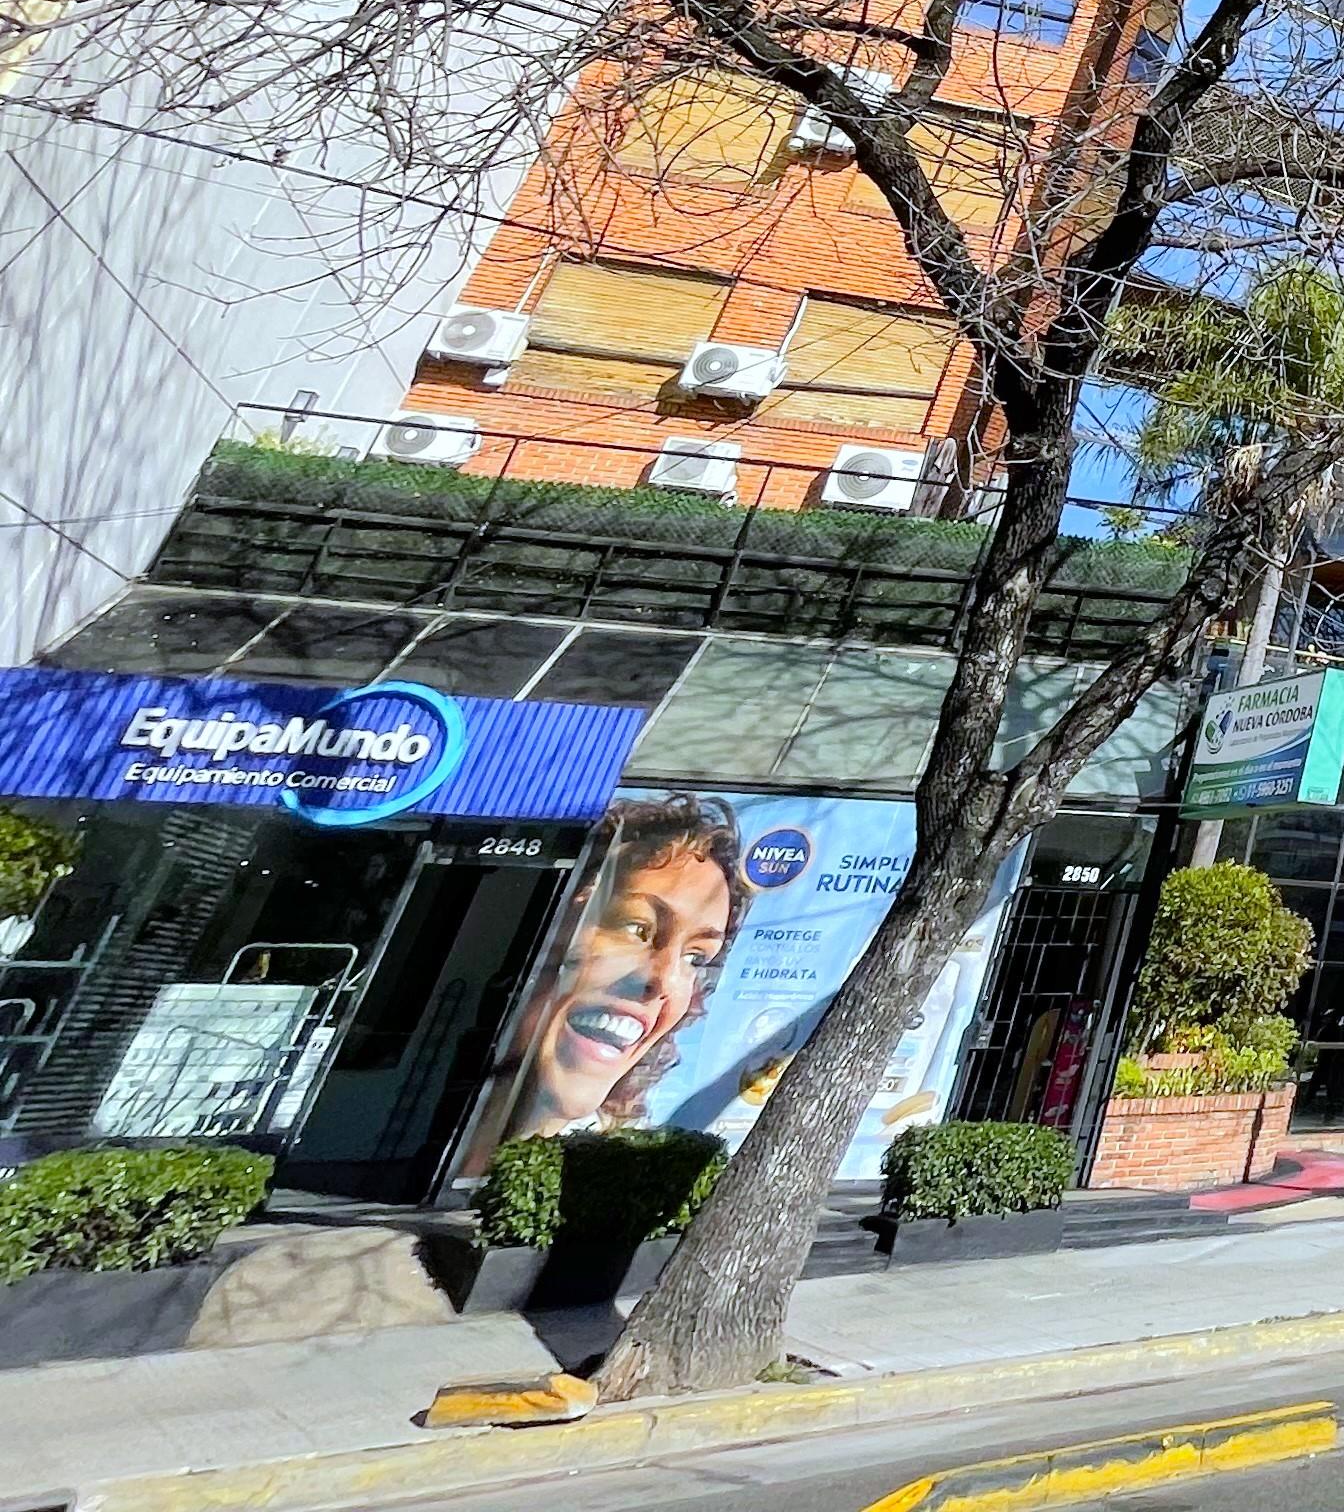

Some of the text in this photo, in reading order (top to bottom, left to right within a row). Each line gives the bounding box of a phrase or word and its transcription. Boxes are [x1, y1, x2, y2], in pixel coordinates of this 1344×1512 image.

[1237, 685, 1299, 713] FARMACIA
[1232, 716, 1263, 733] NUEVA
[120, 706, 432, 763] EquipaMundo
[124, 762, 398, 793] Equipamiento Comercial
[478, 836, 543, 857] 2848
[752, 846, 807, 863] NIVEA
[758, 861, 791, 875] SUN
[753, 929, 823, 942] PROTEGE
[740, 968, 818, 980] E HIDRATA
